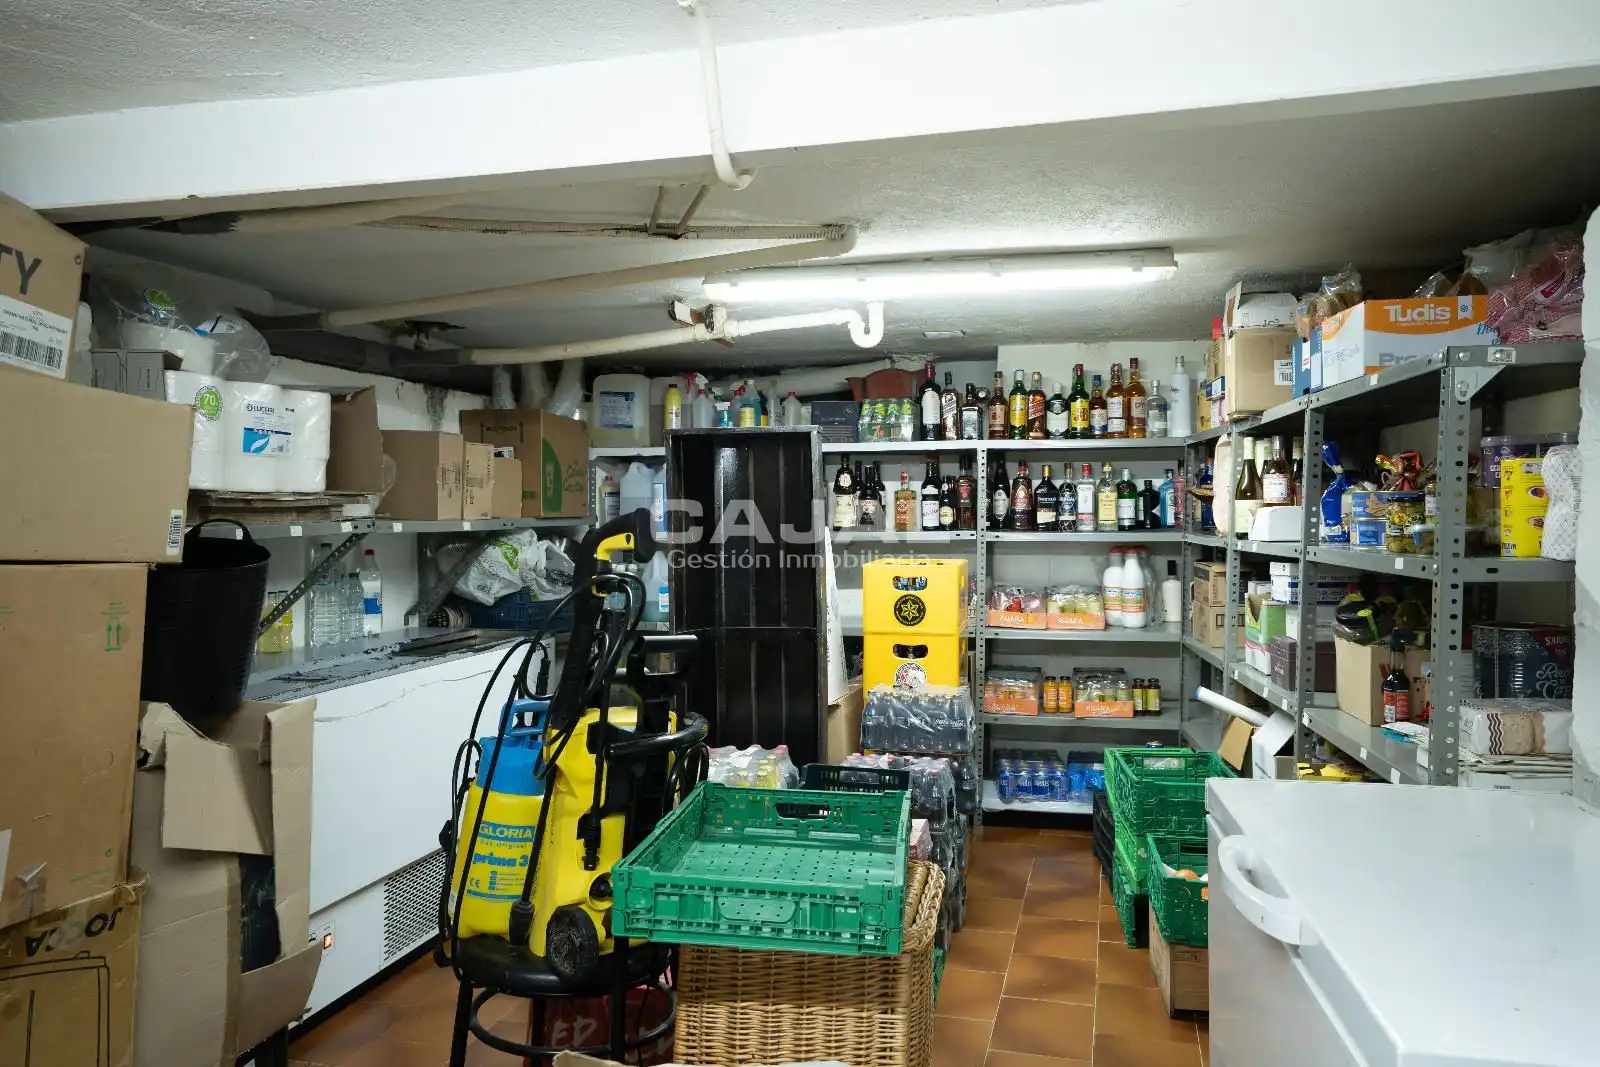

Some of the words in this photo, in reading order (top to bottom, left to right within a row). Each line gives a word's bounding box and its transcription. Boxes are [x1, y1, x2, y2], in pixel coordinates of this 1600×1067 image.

[1383, 304, 1451, 322] Tudis
[203, 393, 216, 405] 70
[480, 823, 533, 839] GLORIA
[473, 852, 517, 867] prima
[518, 854, 529, 867] 3
